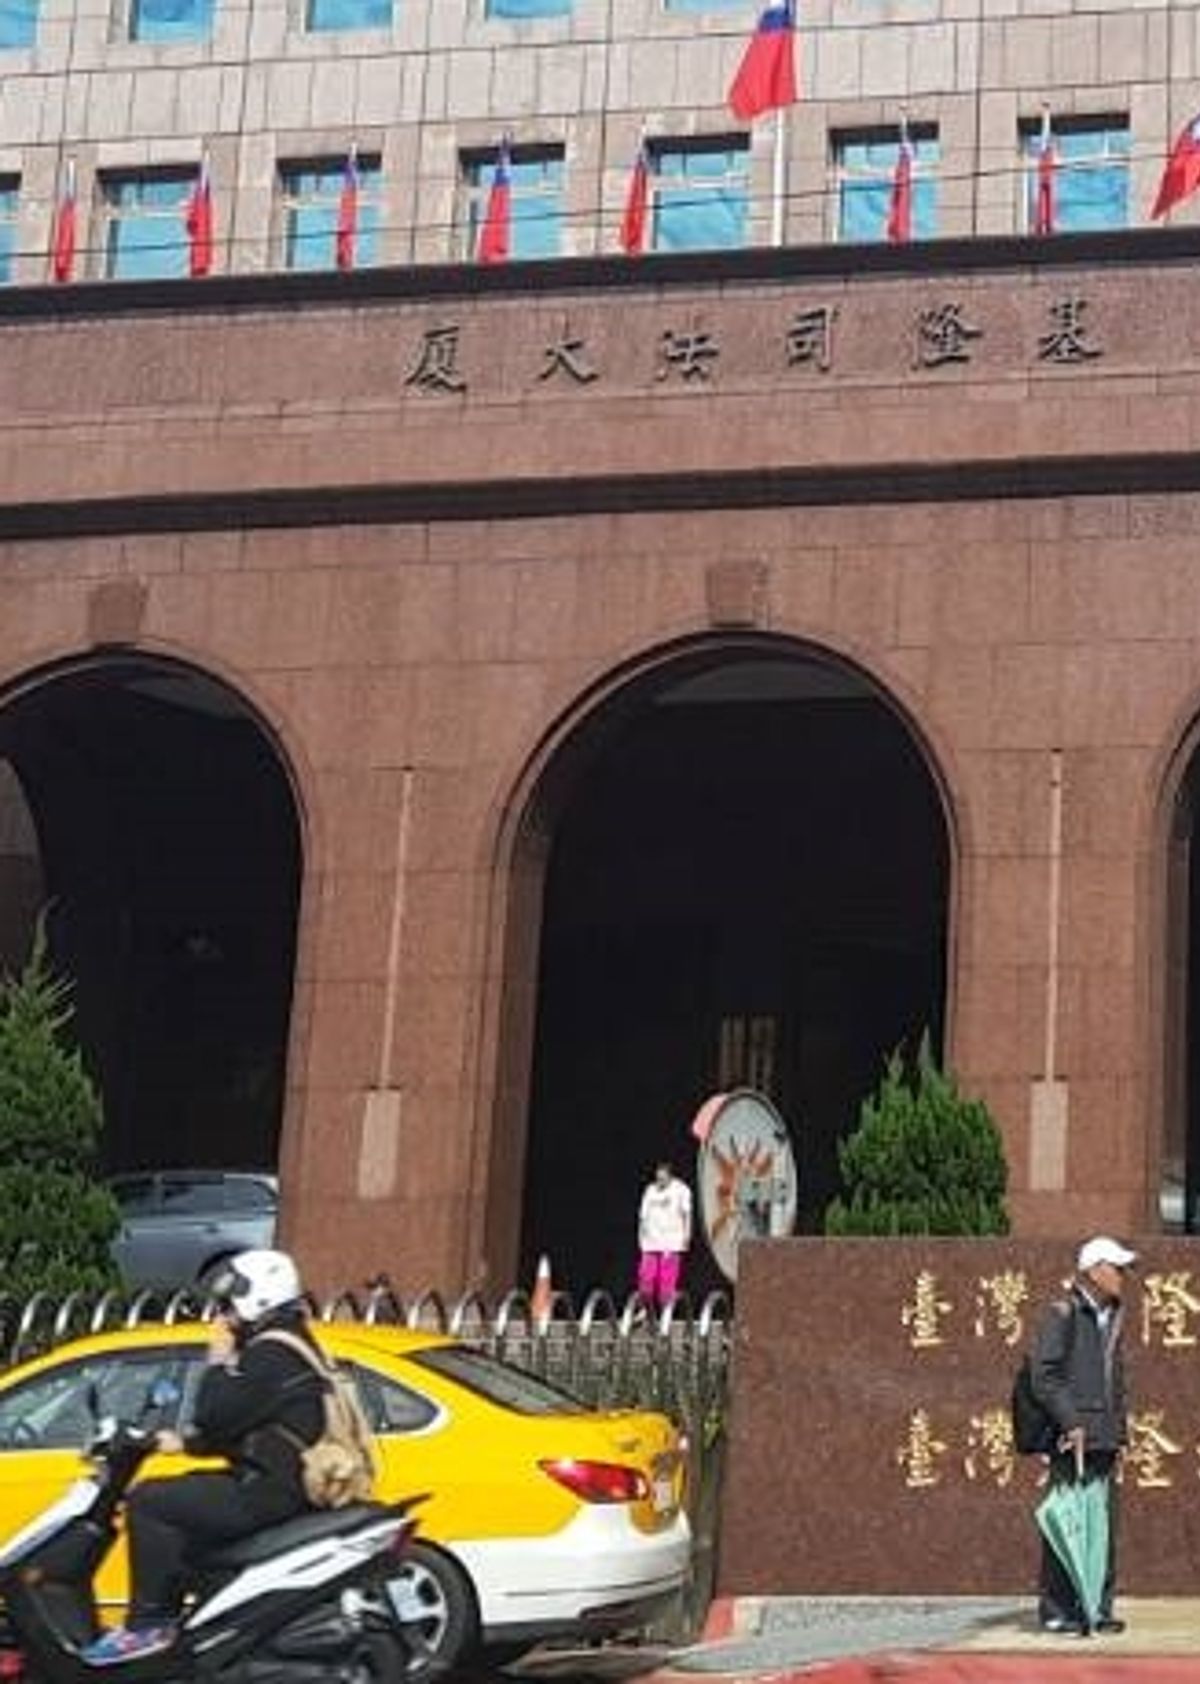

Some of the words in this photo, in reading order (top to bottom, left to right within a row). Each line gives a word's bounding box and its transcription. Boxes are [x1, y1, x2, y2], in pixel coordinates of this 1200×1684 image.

[405, 296, 1102, 393] 基隆司法大廈
